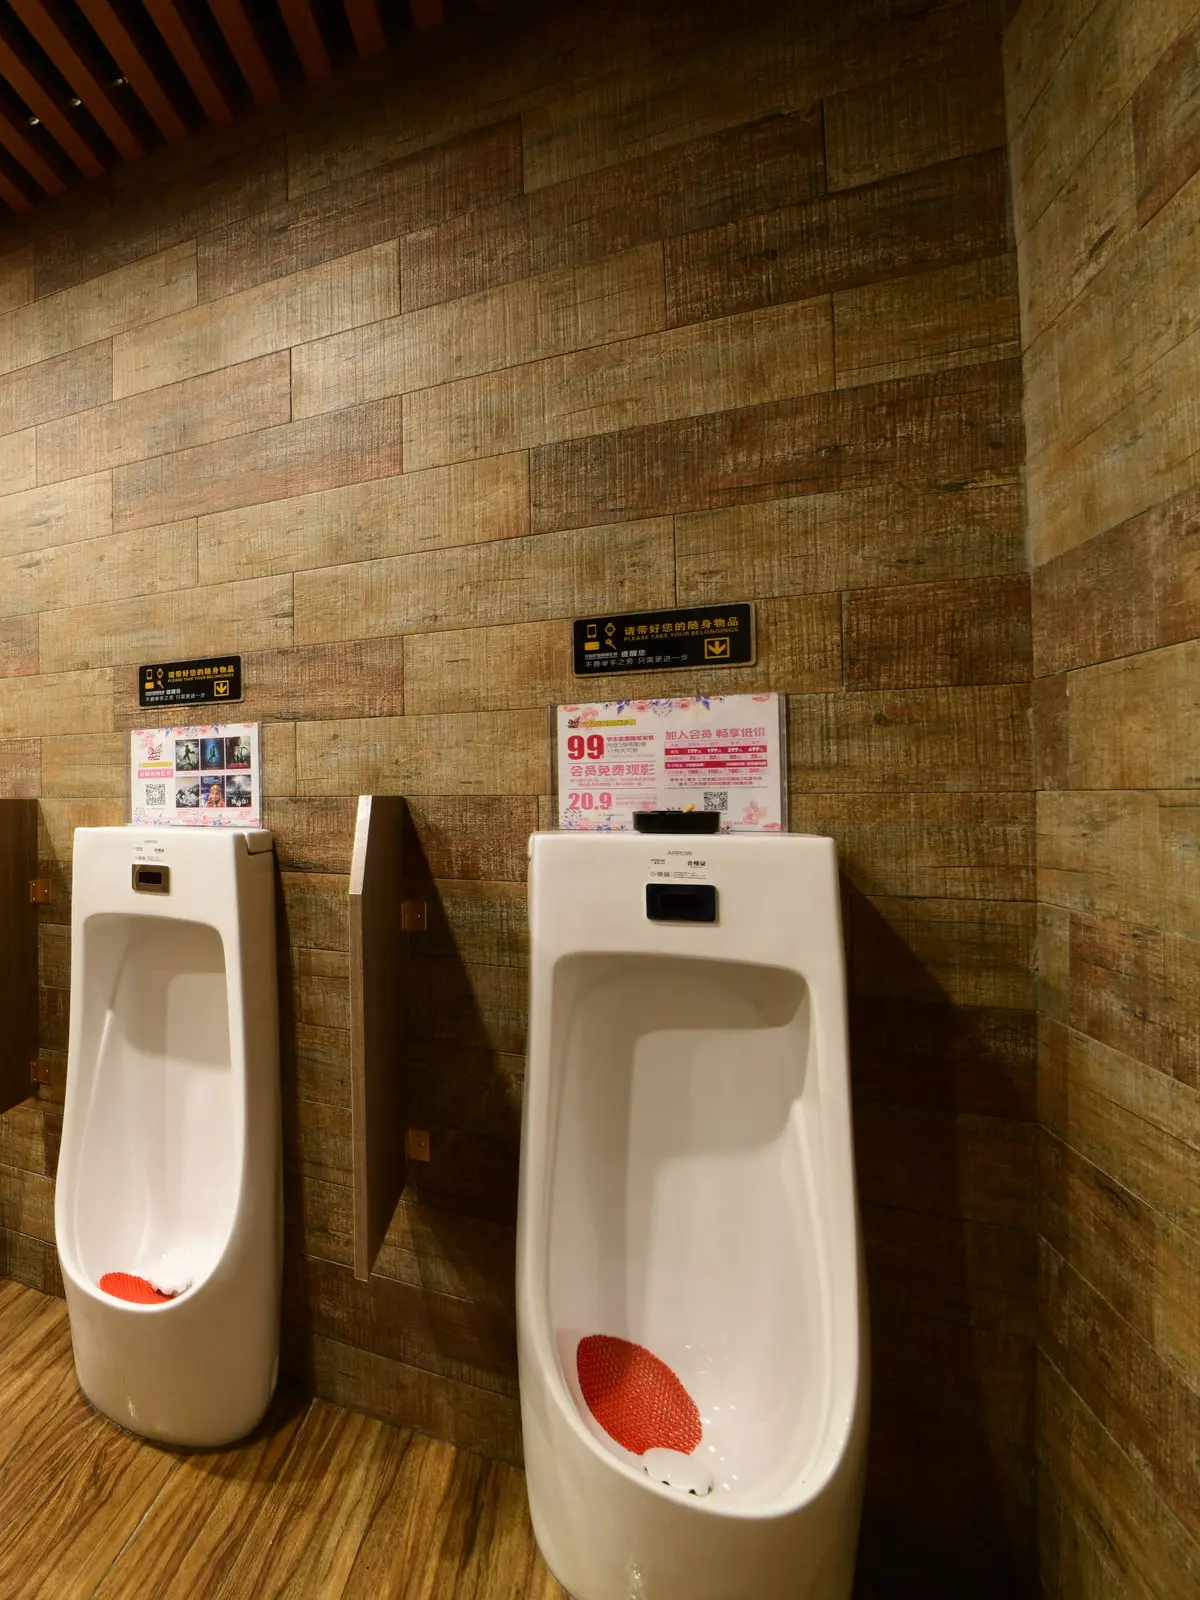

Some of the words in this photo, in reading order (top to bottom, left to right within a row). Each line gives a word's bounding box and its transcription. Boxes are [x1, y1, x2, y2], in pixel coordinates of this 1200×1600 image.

[624, 616, 739, 636] 请带好您的随身物品
[691, 627, 739, 637] BELONGINGS
[621, 649, 646, 658] 提醒您
[637, 653, 689, 664] 只需更进一步
[665, 729, 712, 740] 加入会员
[716, 727, 765, 738] 畅享低价
[567, 734, 605, 760] 99
[570, 763, 656, 777] 会员免费观影
[568, 791, 613, 811] 20.9
